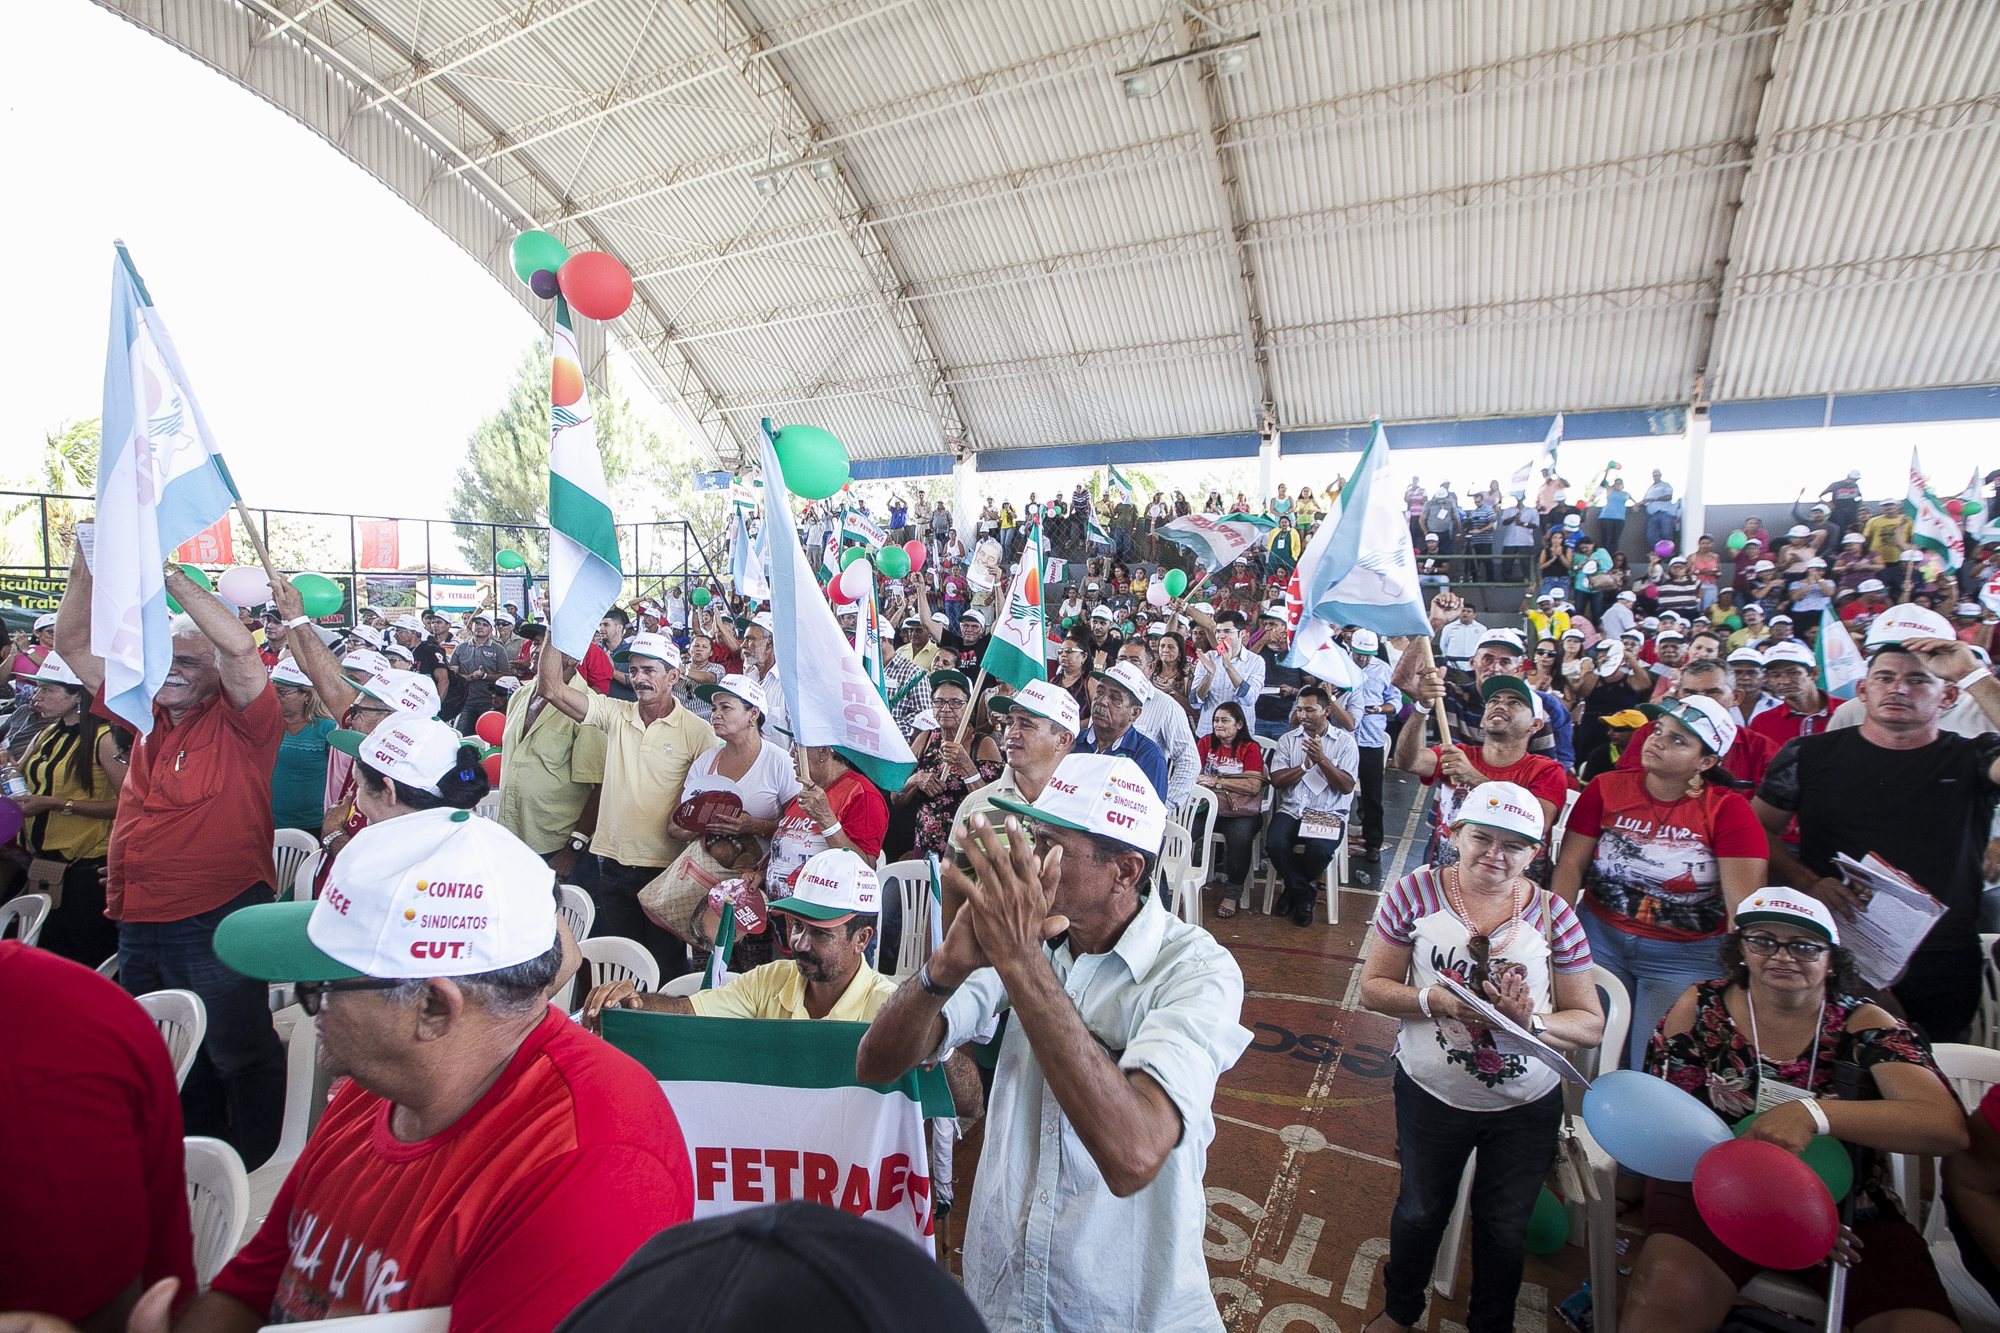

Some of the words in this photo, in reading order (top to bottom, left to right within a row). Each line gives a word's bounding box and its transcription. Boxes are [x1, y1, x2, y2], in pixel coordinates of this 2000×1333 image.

[0, 577, 67, 592] icultura
[18, 595, 61, 610] Trab
[394, 730, 414, 746] CONTAG
[1117, 778, 1146, 796] CONTAG
[1113, 795, 1148, 815] SINDICATOS
[1614, 815, 1652, 835] LULA
[1655, 824, 1704, 840] LIVRE
[429, 881, 483, 899] CONTAG
[859, 894, 874, 902] CUT
[420, 914, 488, 930] SINDICATOS
[694, 1147, 935, 1237] FETRAEC
